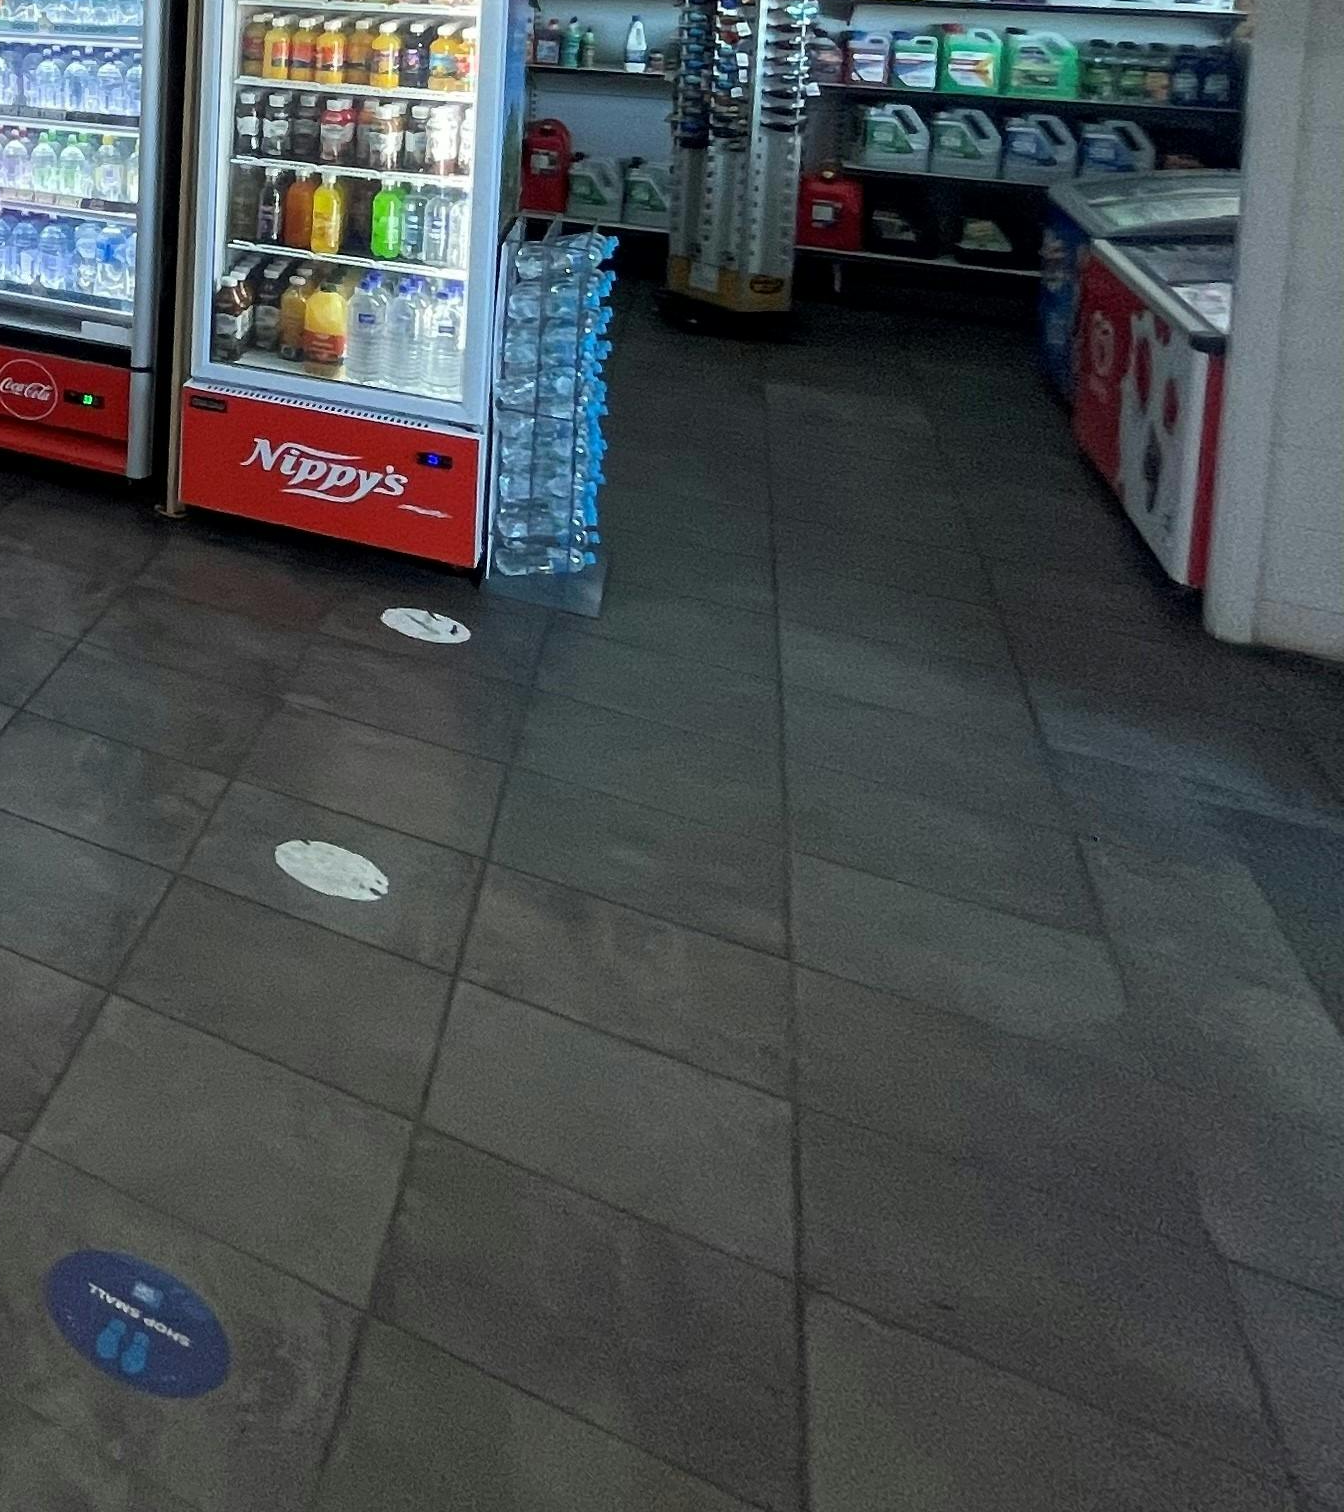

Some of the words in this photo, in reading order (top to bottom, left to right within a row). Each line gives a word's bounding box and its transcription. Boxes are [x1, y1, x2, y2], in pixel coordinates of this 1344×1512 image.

[240, 437, 409, 504] Nippy's
[87, 1281, 141, 1319] SMALL
[143, 1318, 192, 1348] SHOP
